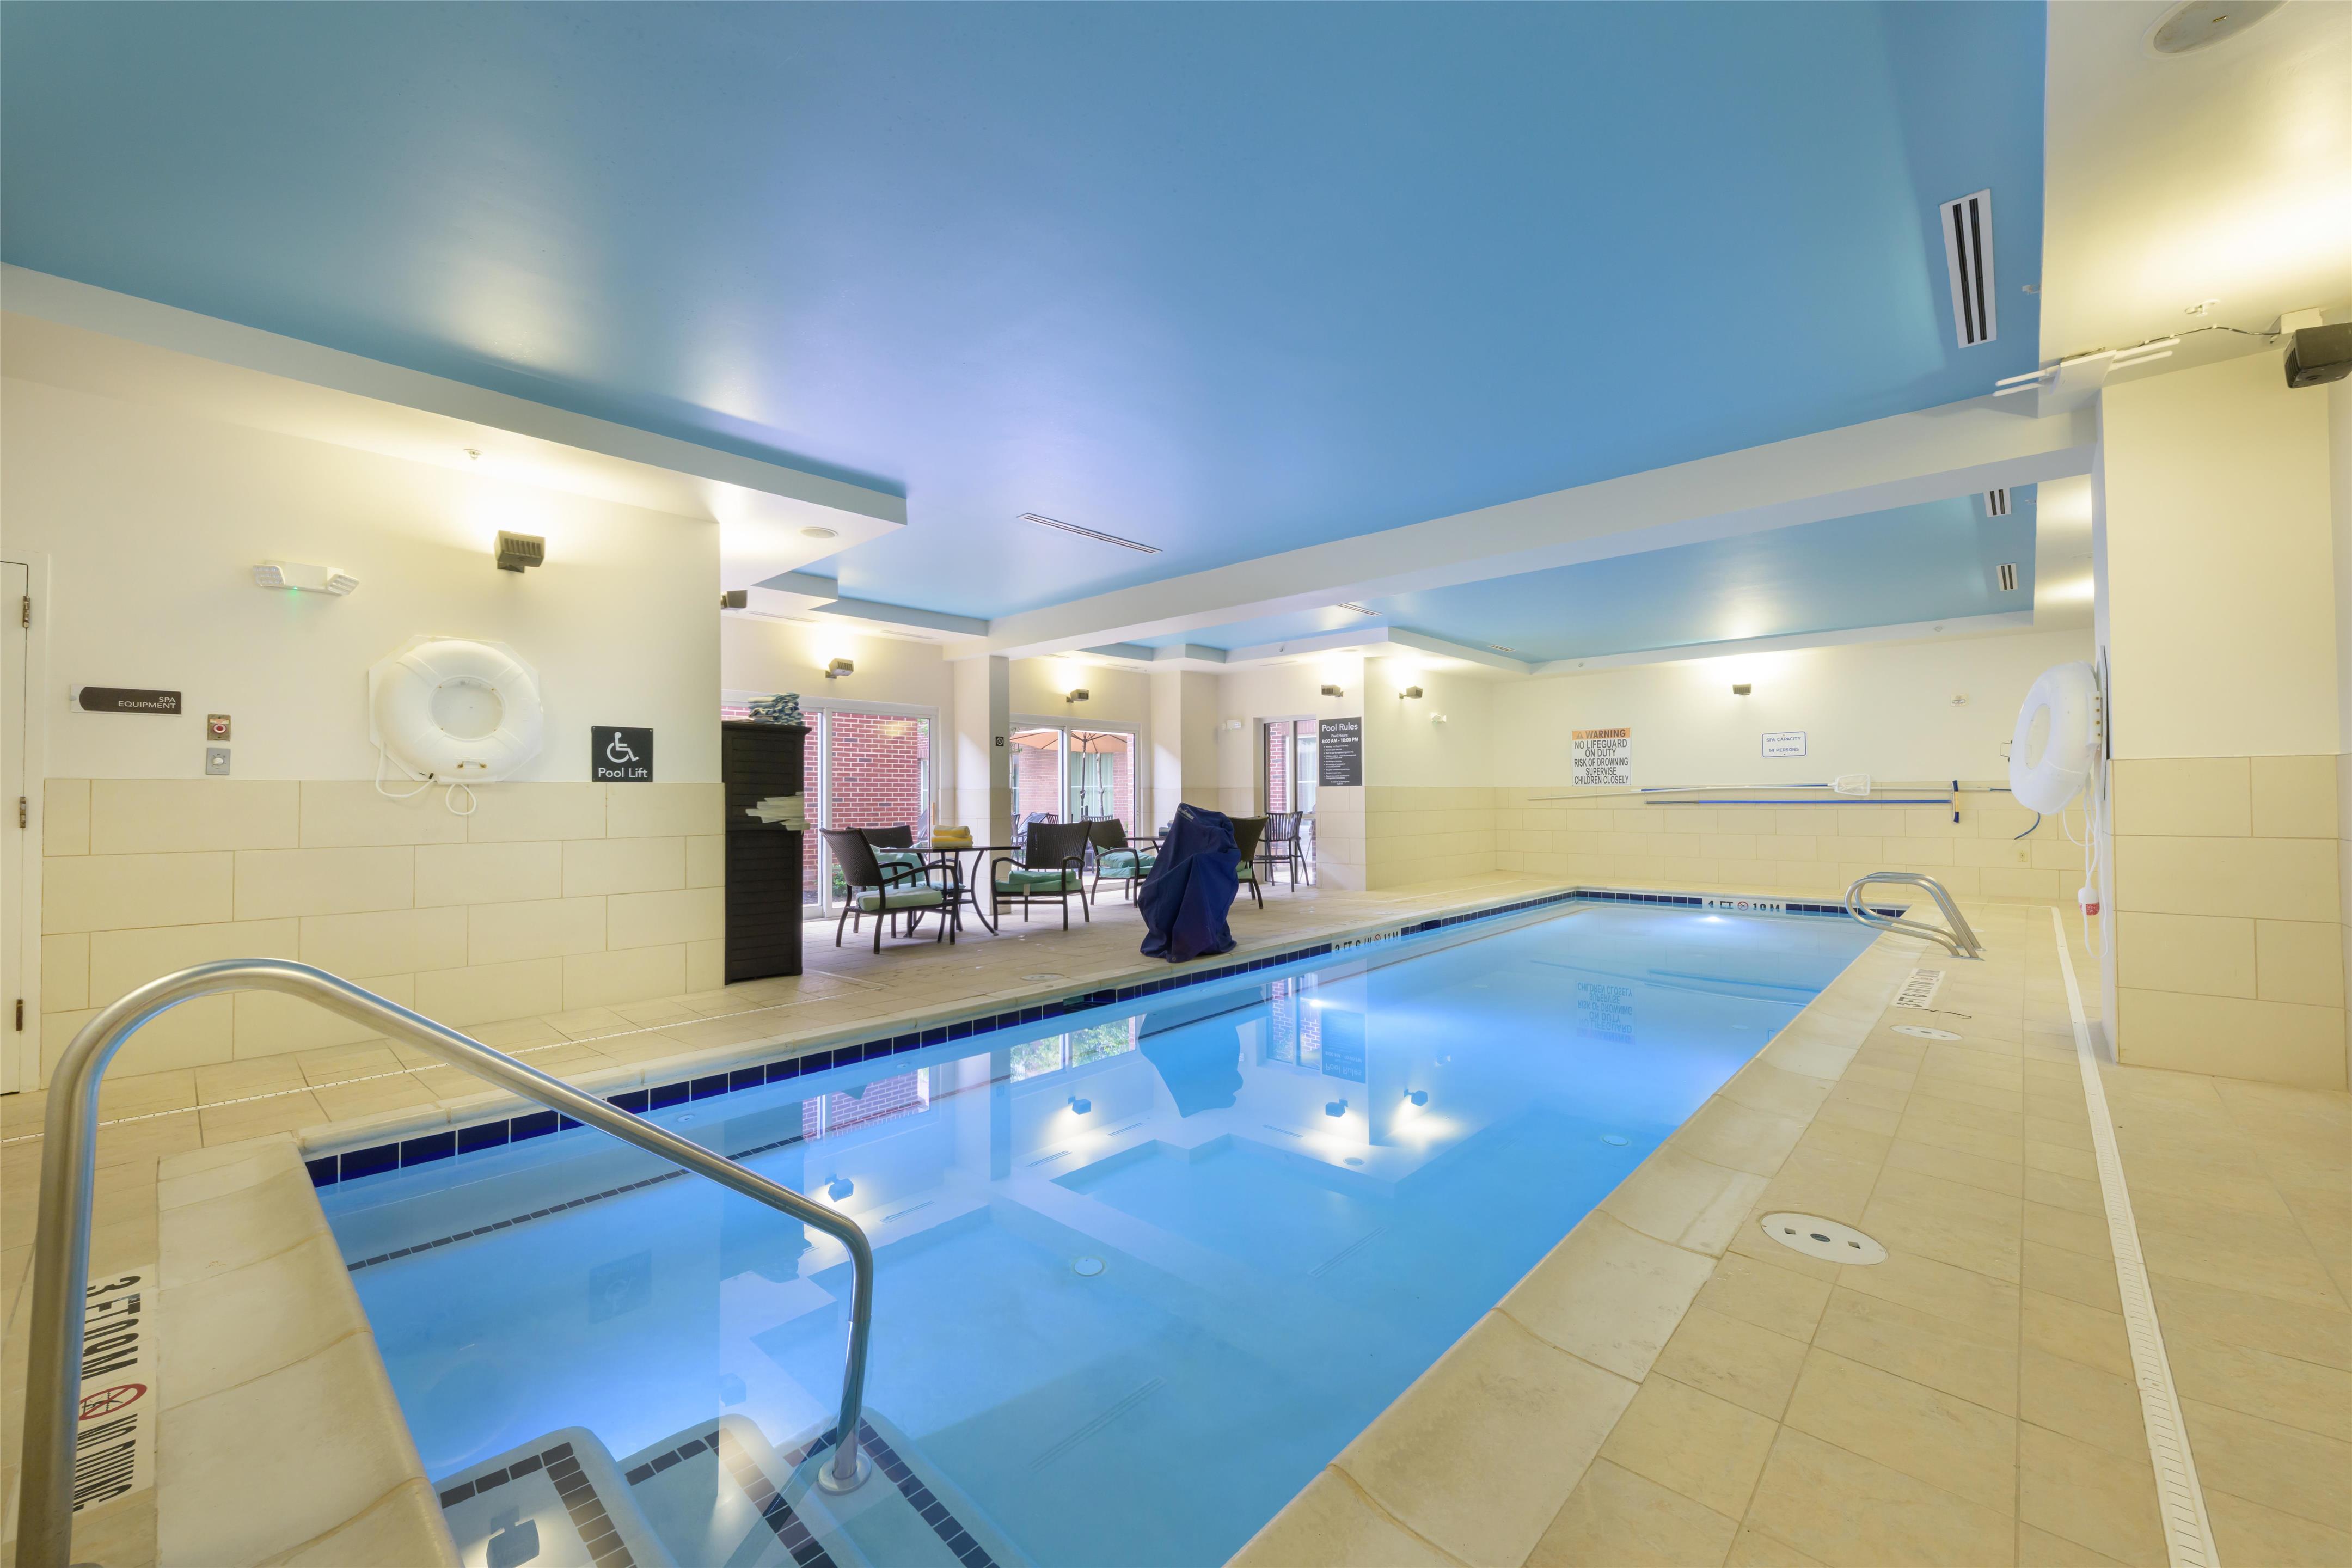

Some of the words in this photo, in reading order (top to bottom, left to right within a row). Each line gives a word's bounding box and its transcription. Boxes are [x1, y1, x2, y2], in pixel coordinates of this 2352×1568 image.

[118, 701, 176, 709] EQUIPMENT
[1322, 723, 1337, 732] Pool
[1339, 722, 1358, 731] Rules
[1585, 729, 1626, 739] WARNING
[1575, 740, 1585, 749] NO
[1587, 739, 1627, 749] LIFEGUARD
[1585, 749, 1595, 757] ON
[1597, 748, 1616, 757] DUTY
[1574, 758, 1587, 767] RISK
[1588, 758, 1596, 767] OF
[1597, 757, 1628, 767] DROWNING
[598, 767, 624, 777] Pool
[629, 768, 648, 777] Lift
[1585, 767, 1616, 776] SUPERVISE
[1575, 776, 1602, 785] CHILDREN
[1603, 775, 1629, 784] CLOSELY
